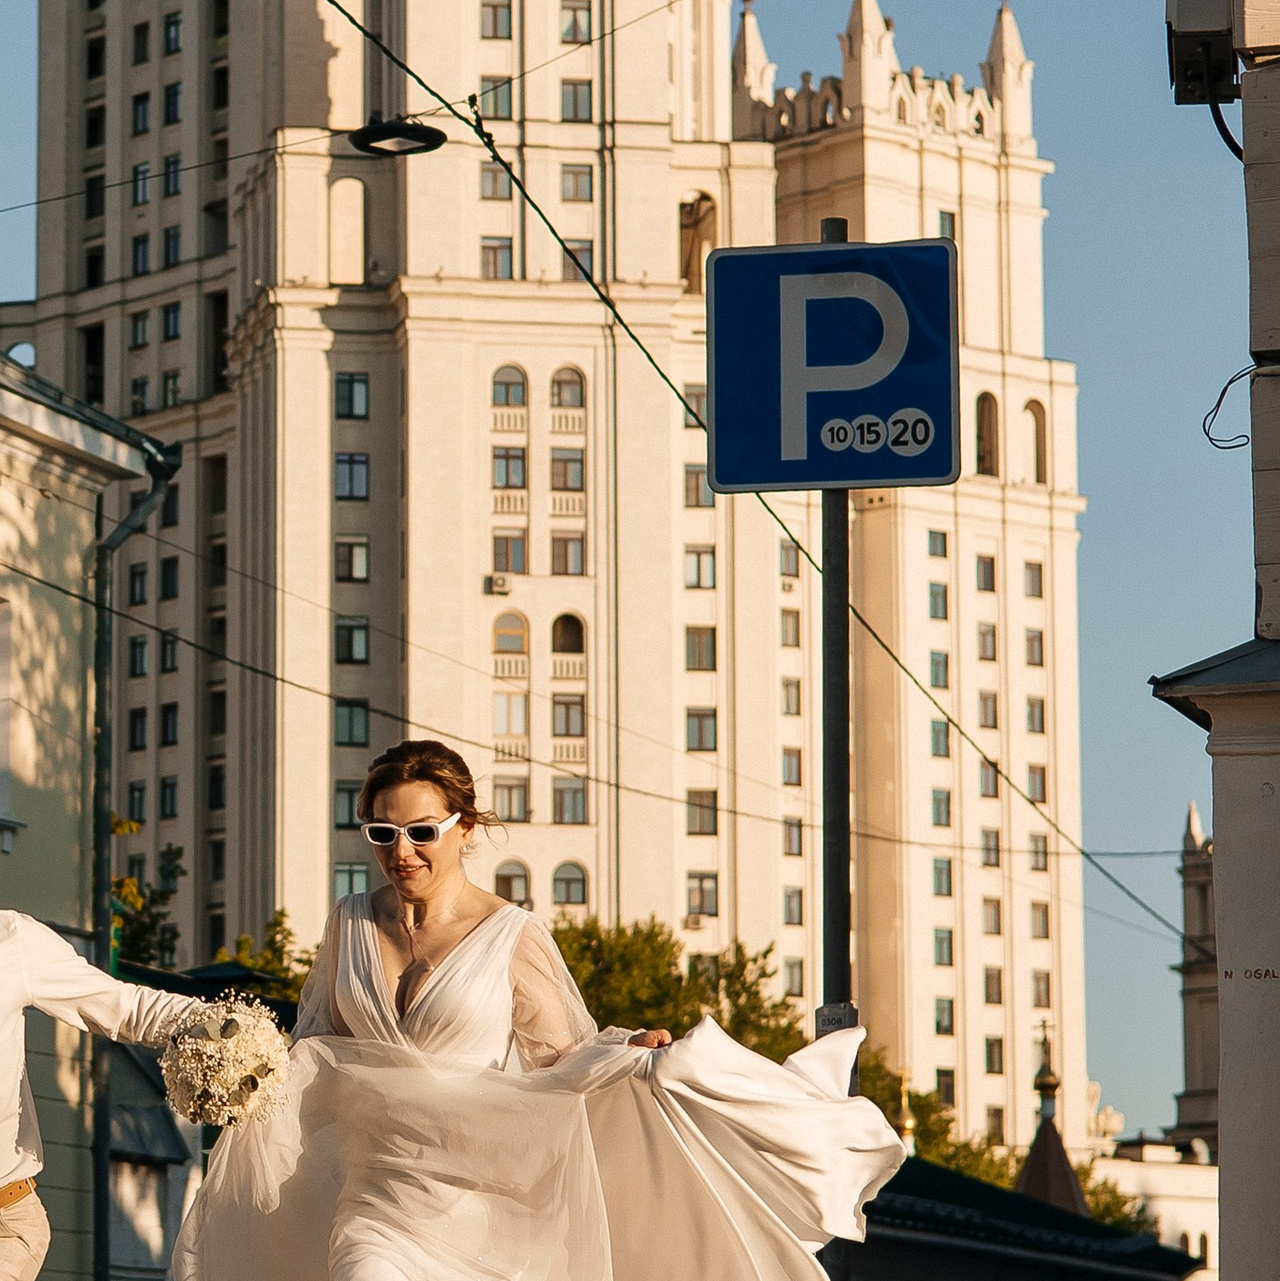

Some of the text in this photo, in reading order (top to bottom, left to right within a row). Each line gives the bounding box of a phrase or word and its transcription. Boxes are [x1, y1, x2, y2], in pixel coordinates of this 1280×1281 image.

[780, 272, 909, 460] P
[827, 418, 930, 446] 10 15 20
[821, 1017, 843, 1026] 0308
